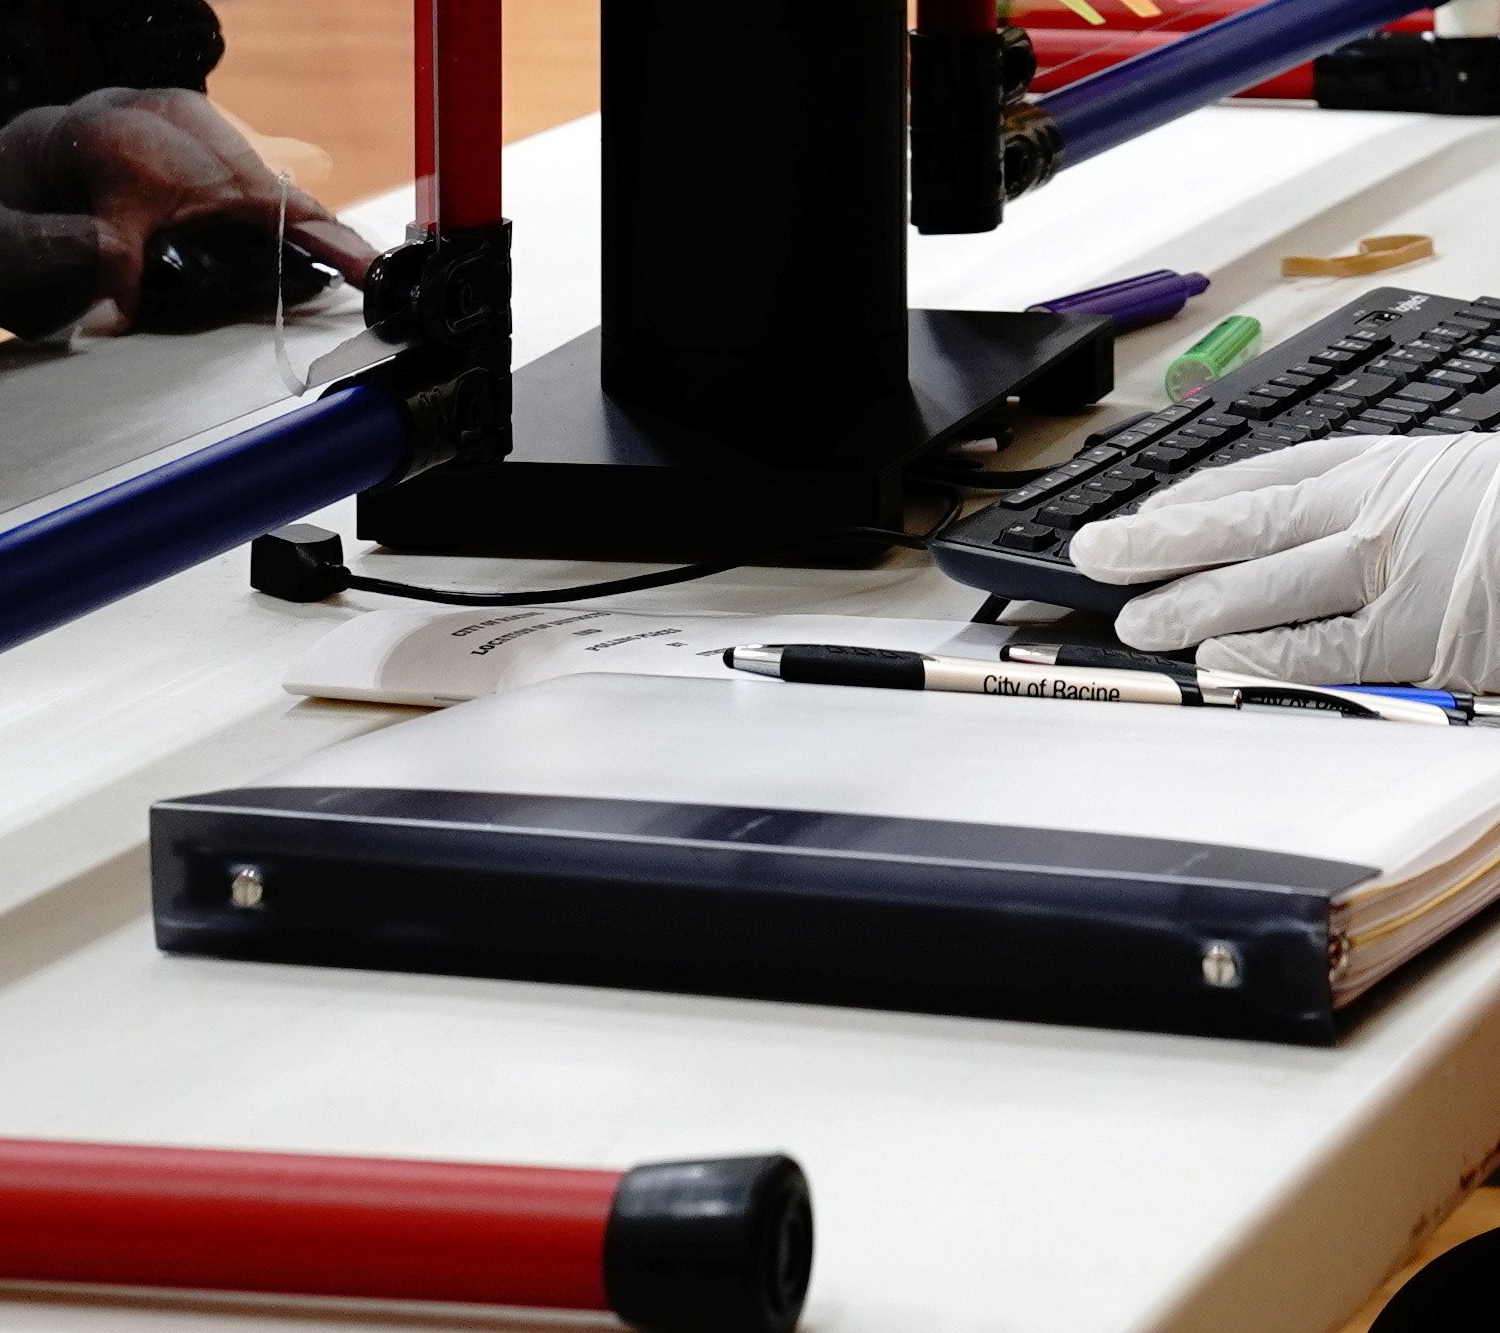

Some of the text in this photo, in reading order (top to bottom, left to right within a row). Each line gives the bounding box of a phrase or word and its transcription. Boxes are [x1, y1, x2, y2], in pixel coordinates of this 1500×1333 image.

[470, 628, 534, 656] LOCATION
[983, 674, 1120, 702] City of Racine
